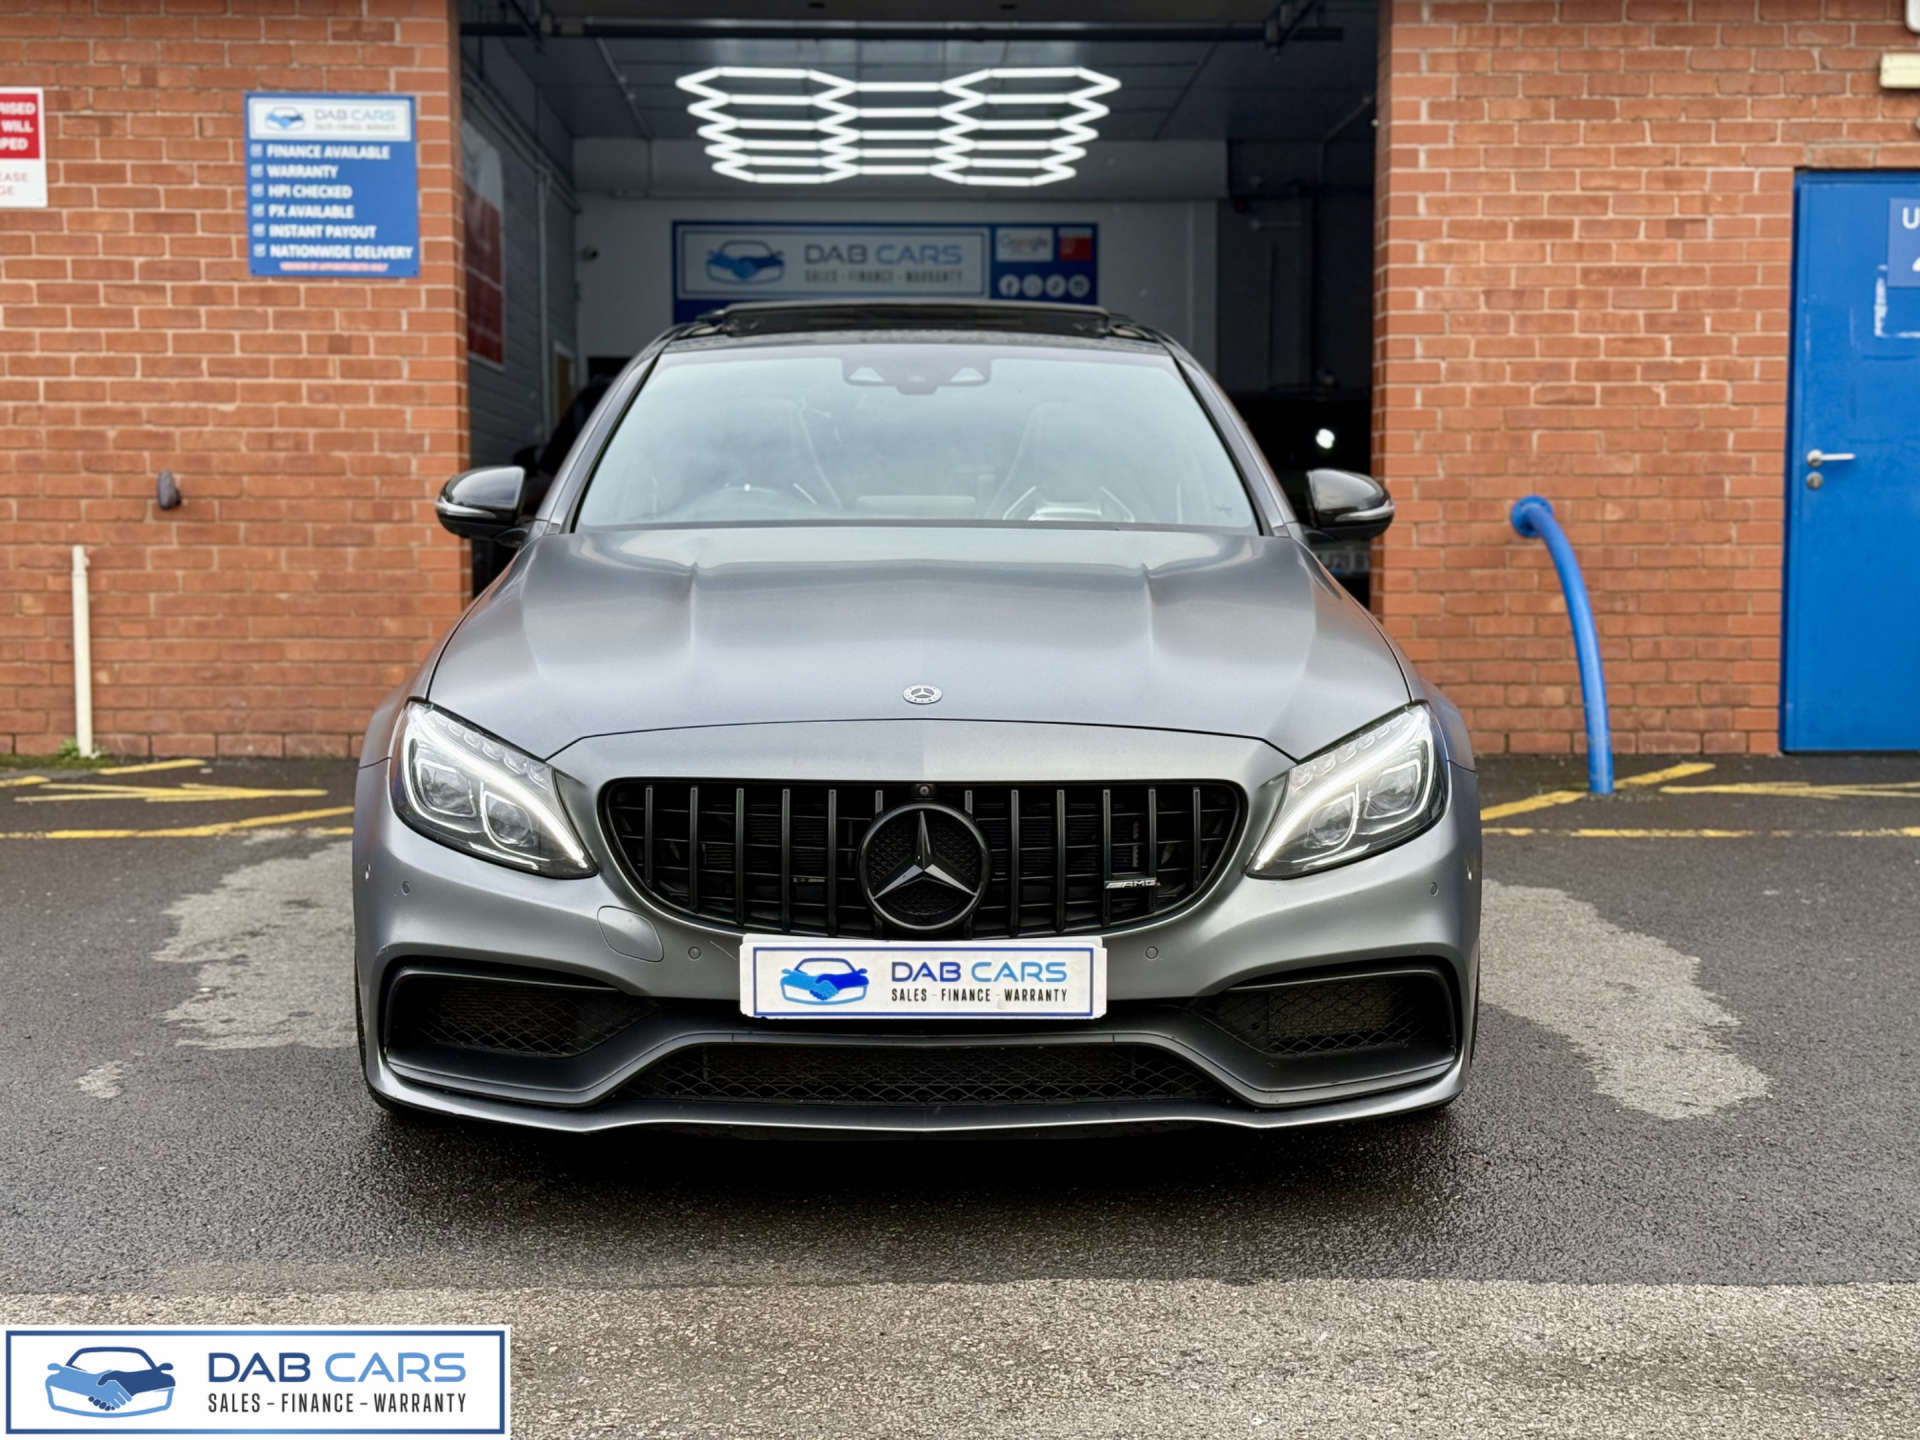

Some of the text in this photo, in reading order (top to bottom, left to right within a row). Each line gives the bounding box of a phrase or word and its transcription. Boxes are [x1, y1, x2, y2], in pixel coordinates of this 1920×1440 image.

[314, 108, 397, 123] DAB CARS
[2, 119, 34, 132] WILL
[267, 145, 390, 160] FINANCE AVAILABLE
[267, 165, 339, 179] WARRANTY
[268, 184, 353, 199] HPI CHECKED
[269, 204, 354, 219] PX AVAILABLE
[269, 224, 376, 239] INSTANT PAYOUT
[270, 245, 413, 259] NATIONWIDE DELIVERY
[804, 244, 962, 265] DAB CARS
[891, 961, 1068, 983] DAB CARS
[891, 988, 927, 1002] SALES
[941, 988, 991, 1002] FINANCE
[1005, 988, 1067, 1002] WARRANTY
